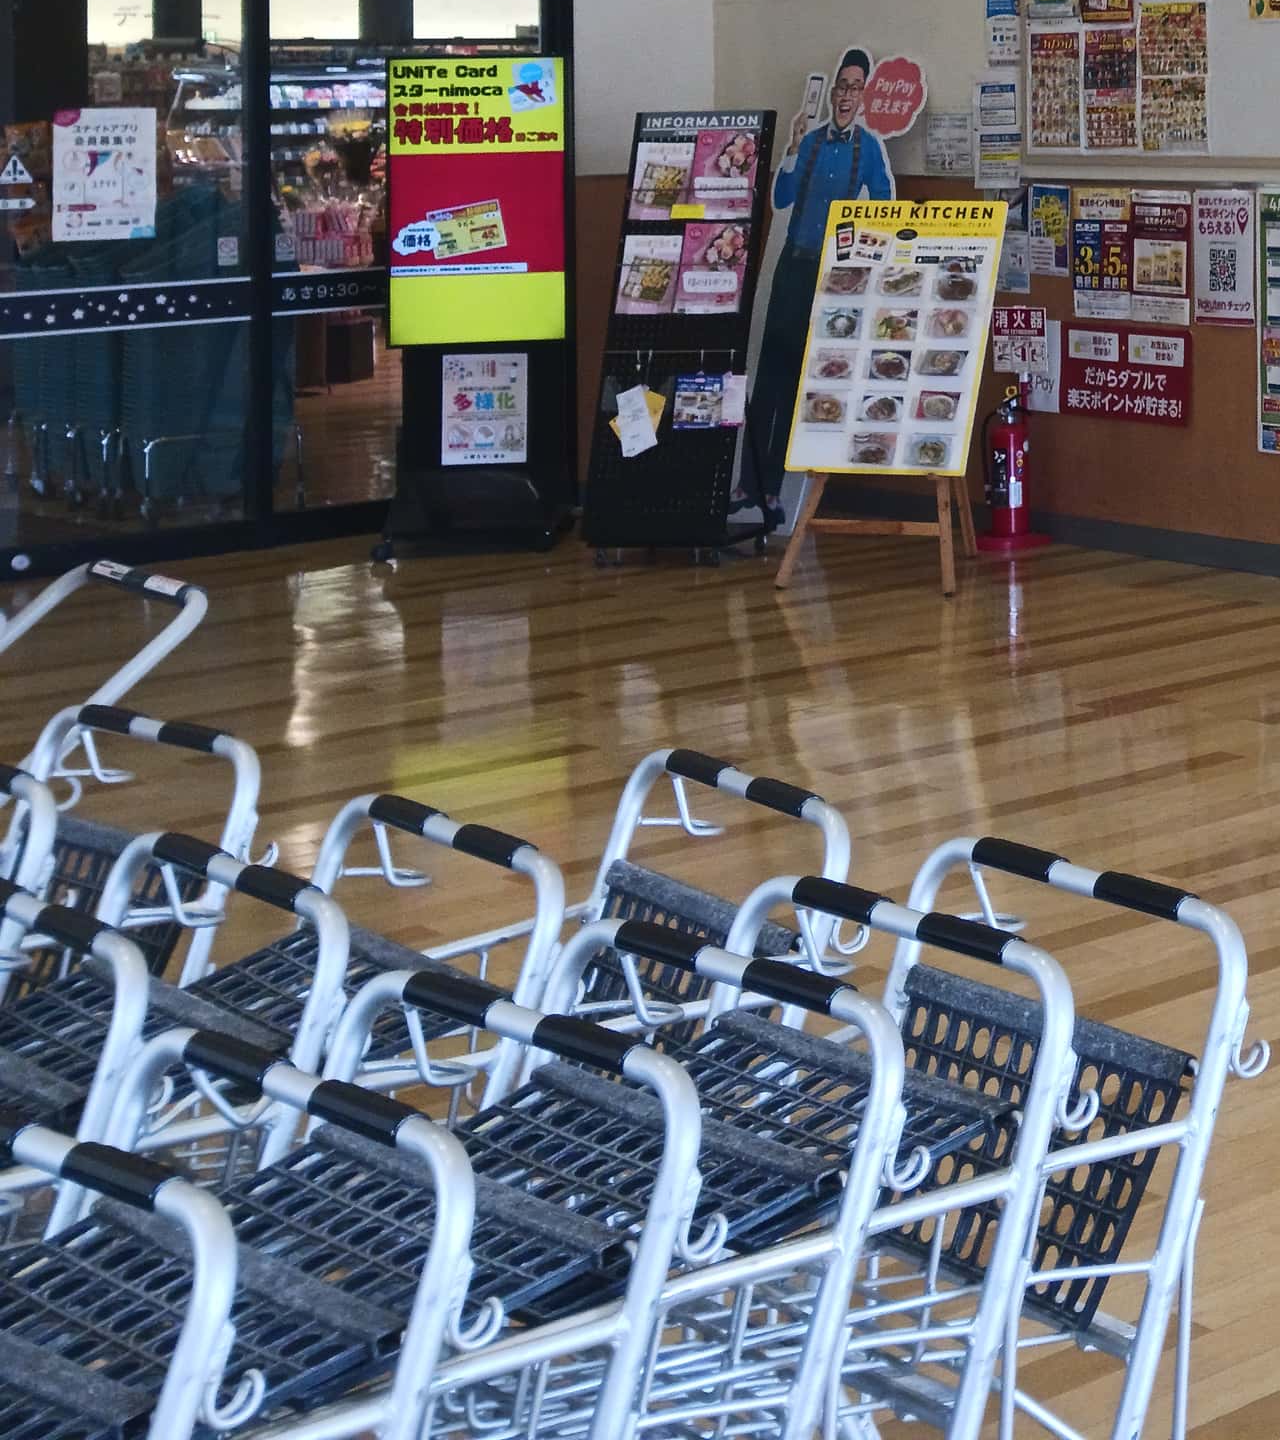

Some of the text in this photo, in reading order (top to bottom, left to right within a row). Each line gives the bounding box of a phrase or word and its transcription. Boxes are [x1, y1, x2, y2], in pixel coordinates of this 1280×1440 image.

[455, 64, 498, 78] Card
[874, 78, 917, 97] PayPay
[870, 98, 913, 115] 使えます
[71, 123, 139, 134] ユナイトアプリ
[646, 115, 759, 129] INFORMATION
[393, 116, 514, 146] 特別価格
[74, 135, 137, 146] 会員募集中
[841, 206, 995, 220] DELISH KITCHEN
[994, 309, 1043, 329] 消火器
[1084, 366, 1168, 392] だからダブルで
[1067, 388, 1183, 419] 楽天ポイントが貯まる!
